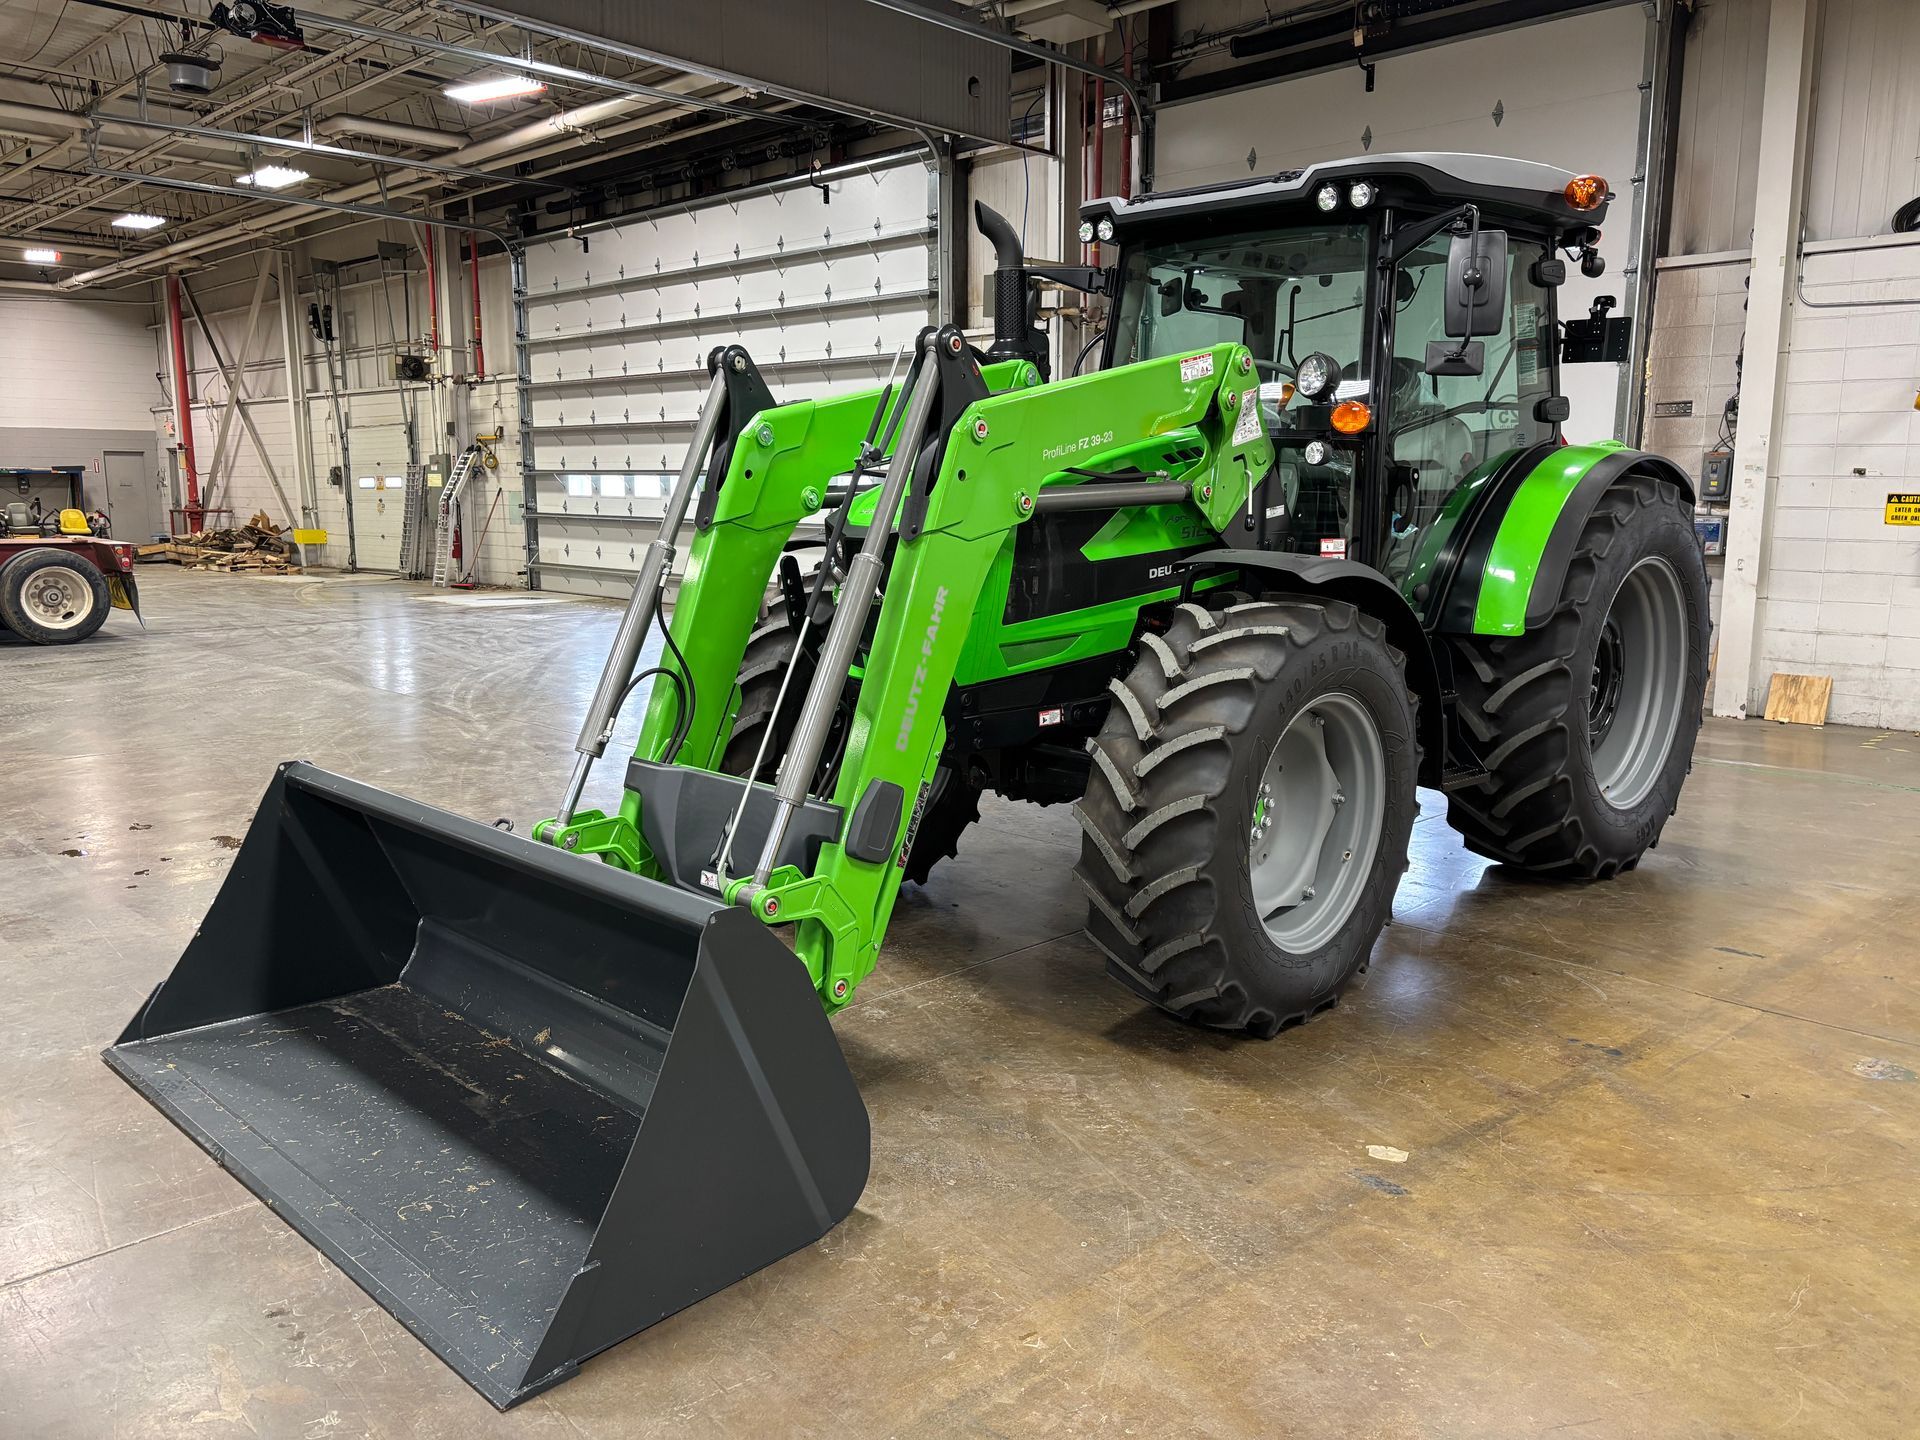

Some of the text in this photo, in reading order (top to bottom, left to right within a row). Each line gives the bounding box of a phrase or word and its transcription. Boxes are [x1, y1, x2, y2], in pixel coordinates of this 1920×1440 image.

[1042, 430, 1113, 461] ProfiLine FZ 39-23
[1901, 495, 1920, 503] CAUTI
[895, 585, 950, 753] DEUTZ-FAHR
